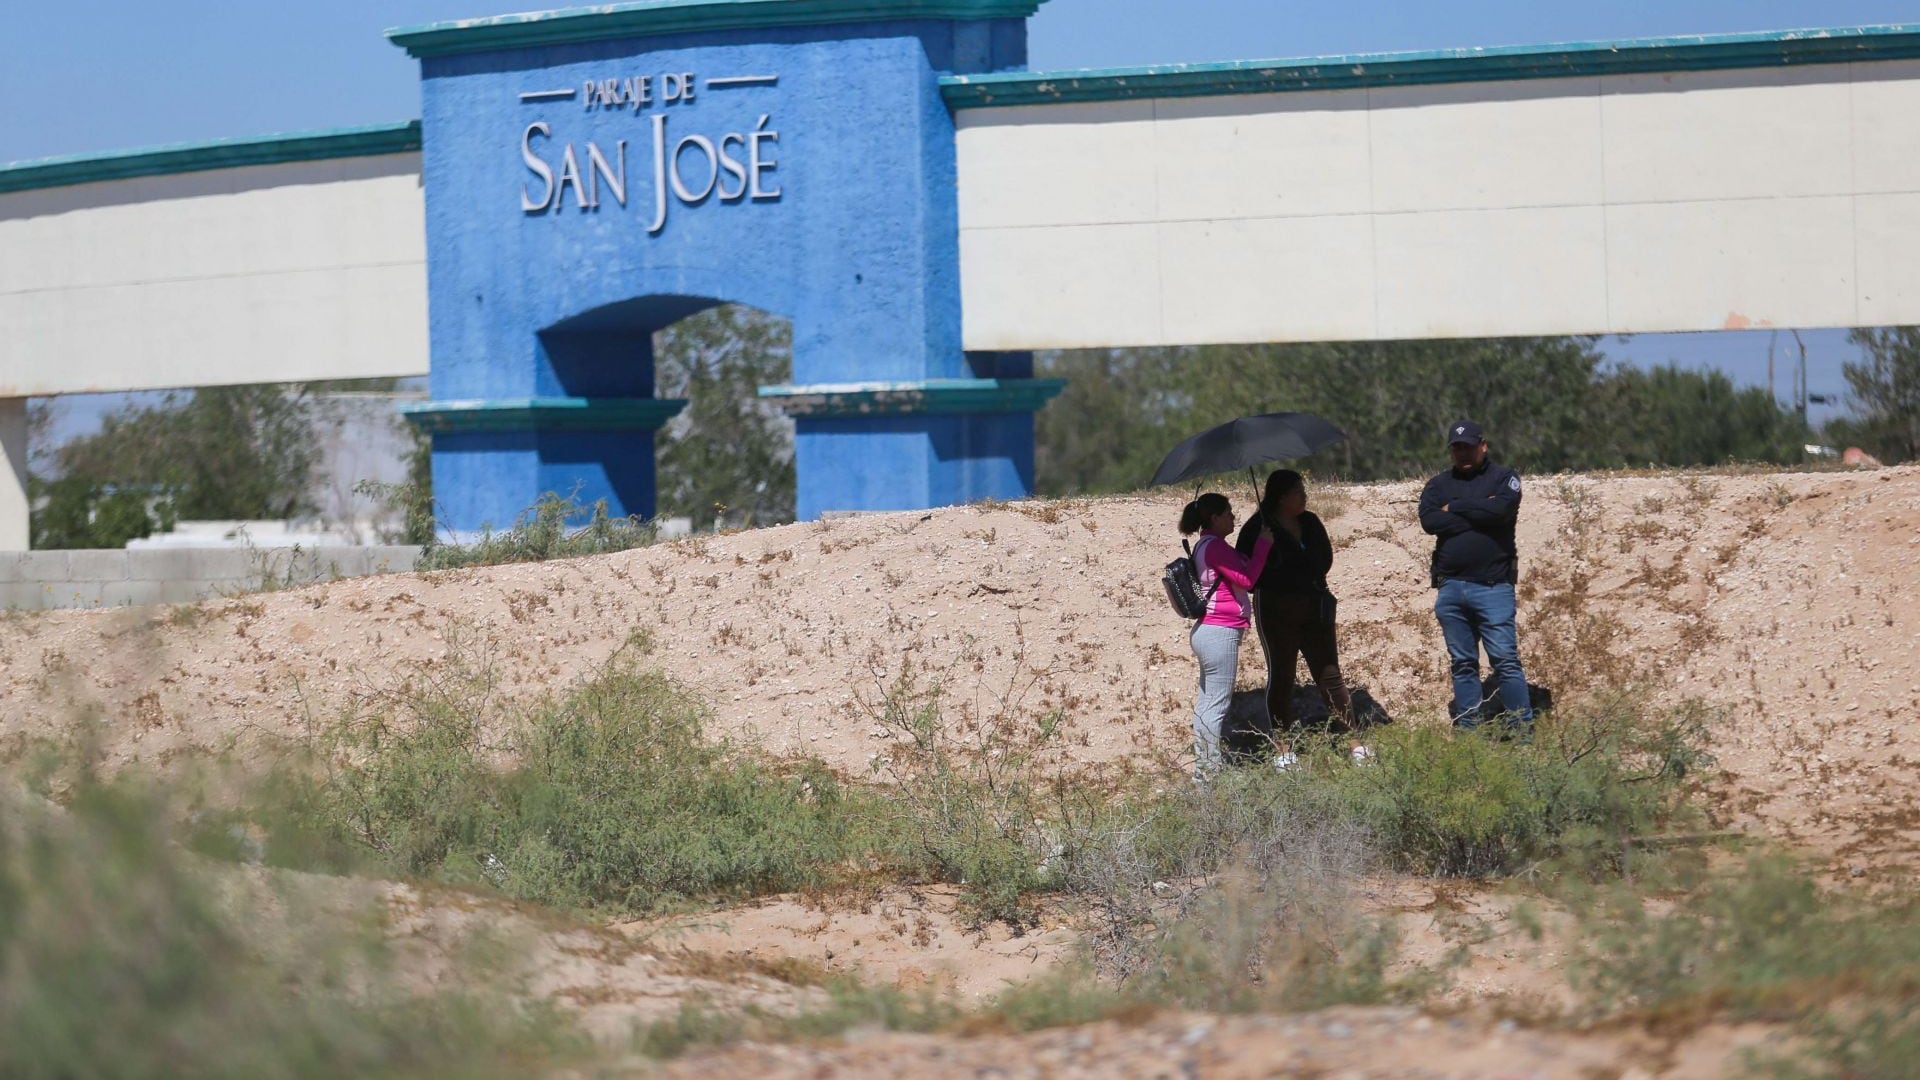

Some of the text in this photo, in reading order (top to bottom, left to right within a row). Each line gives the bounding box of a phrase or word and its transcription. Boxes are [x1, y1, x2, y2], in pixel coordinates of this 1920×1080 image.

[584, 71, 696, 111] PARAJE DE
[521, 113, 782, 232] SAN JOSÉ
